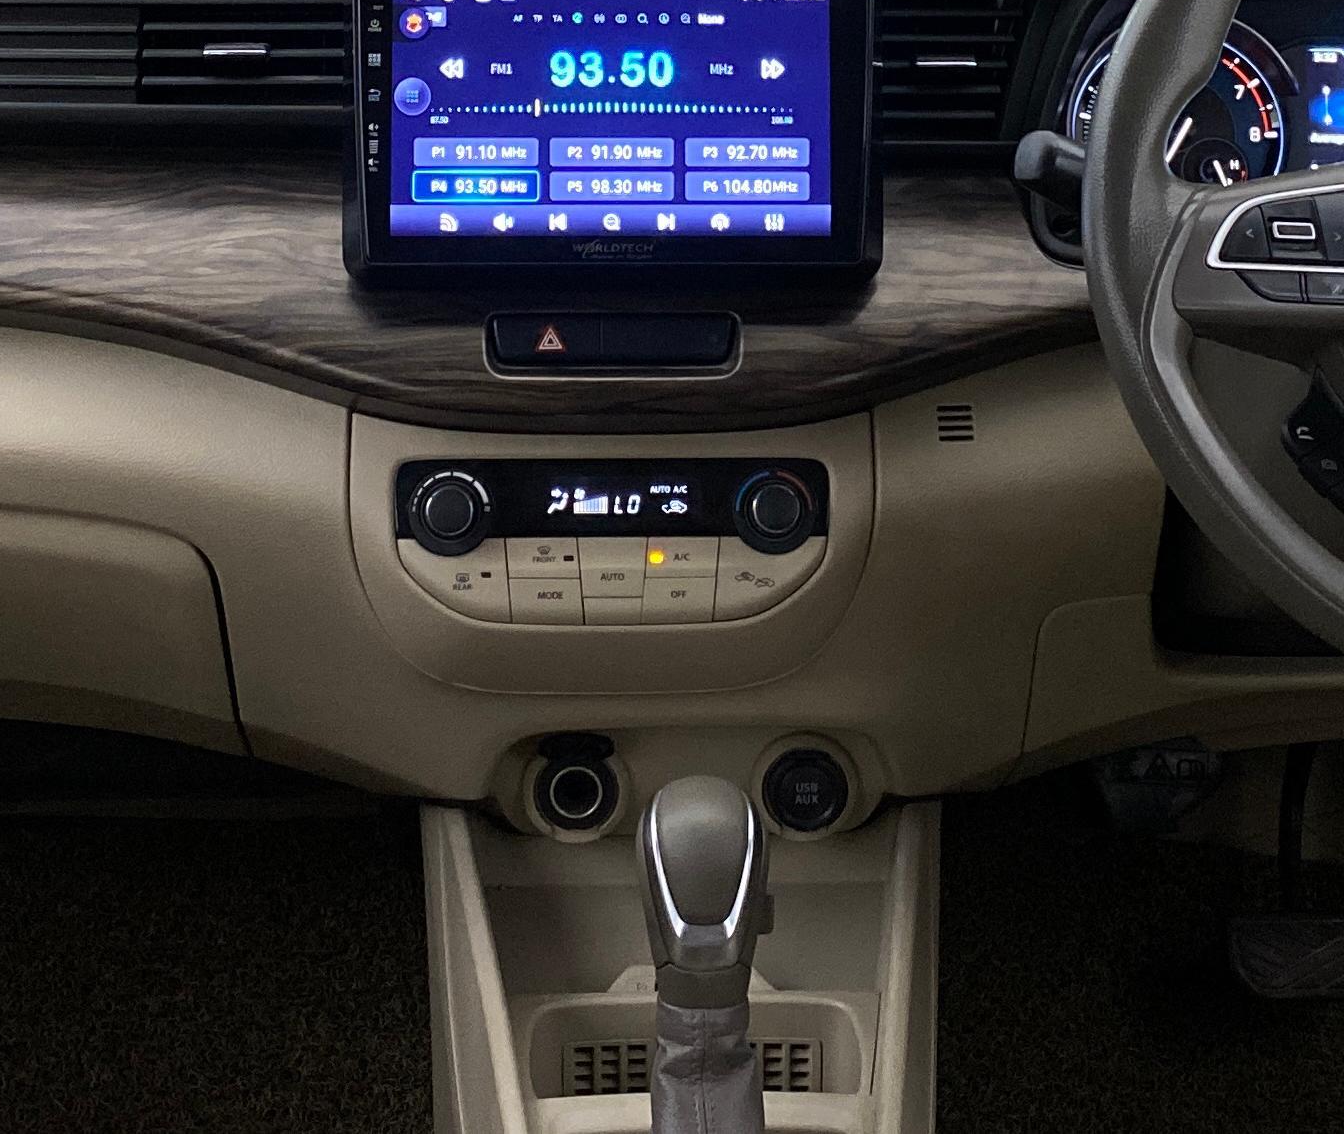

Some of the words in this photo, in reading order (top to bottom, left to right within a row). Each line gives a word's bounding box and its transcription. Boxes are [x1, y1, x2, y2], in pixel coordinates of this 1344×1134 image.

[512, 14, 524, 23] AF
[533, 14, 543, 23] TP
[552, 14, 563, 23] TA
[697, 13, 725, 25] None
[490, 62, 513, 76] FM1
[549, 50, 674, 88] 93.50
[709, 63, 734, 76] MHz
[1234, 84, 1245, 100] 7
[1249, 126, 1261, 142] 8
[431, 145, 446, 159] P1
[456, 144, 497, 161] 91.10
[501, 146, 527, 159] MHz
[567, 145, 583, 159] P2
[591, 144, 632, 161] 91.90
[636, 146, 663, 159] MHz
[703, 145, 719, 159] P3
[726, 144, 768, 161] 92.70
[772, 146, 798, 159] MHz
[1229, 159, 1240, 170] H
[430, 179, 448, 194] P4
[455, 178, 497, 195] 93.50
[500, 180, 528, 194] MHz
[567, 180, 583, 194] P5
[591, 179, 632, 195] 98.30
[636, 181, 663, 194] MHz
[703, 180, 719, 194] P6
[723, 179, 772, 195] 104.80
[772, 181, 798, 194] MHz
[572, 240, 654, 255] WORLDTECH
[649, 484, 671, 494] AUTO
[673, 484, 688, 494] A/C
[613, 494, 641, 514] LO
[532, 555, 556, 563] FRONT
[673, 553, 690, 562] A/C
[600, 572, 625, 581] AUTO
[453, 583, 472, 591] REAR
[537, 591, 564, 600] MODE
[670, 590, 687, 599] OFF
[795, 782, 818, 793] USB
[795, 794, 819, 805] AUX
